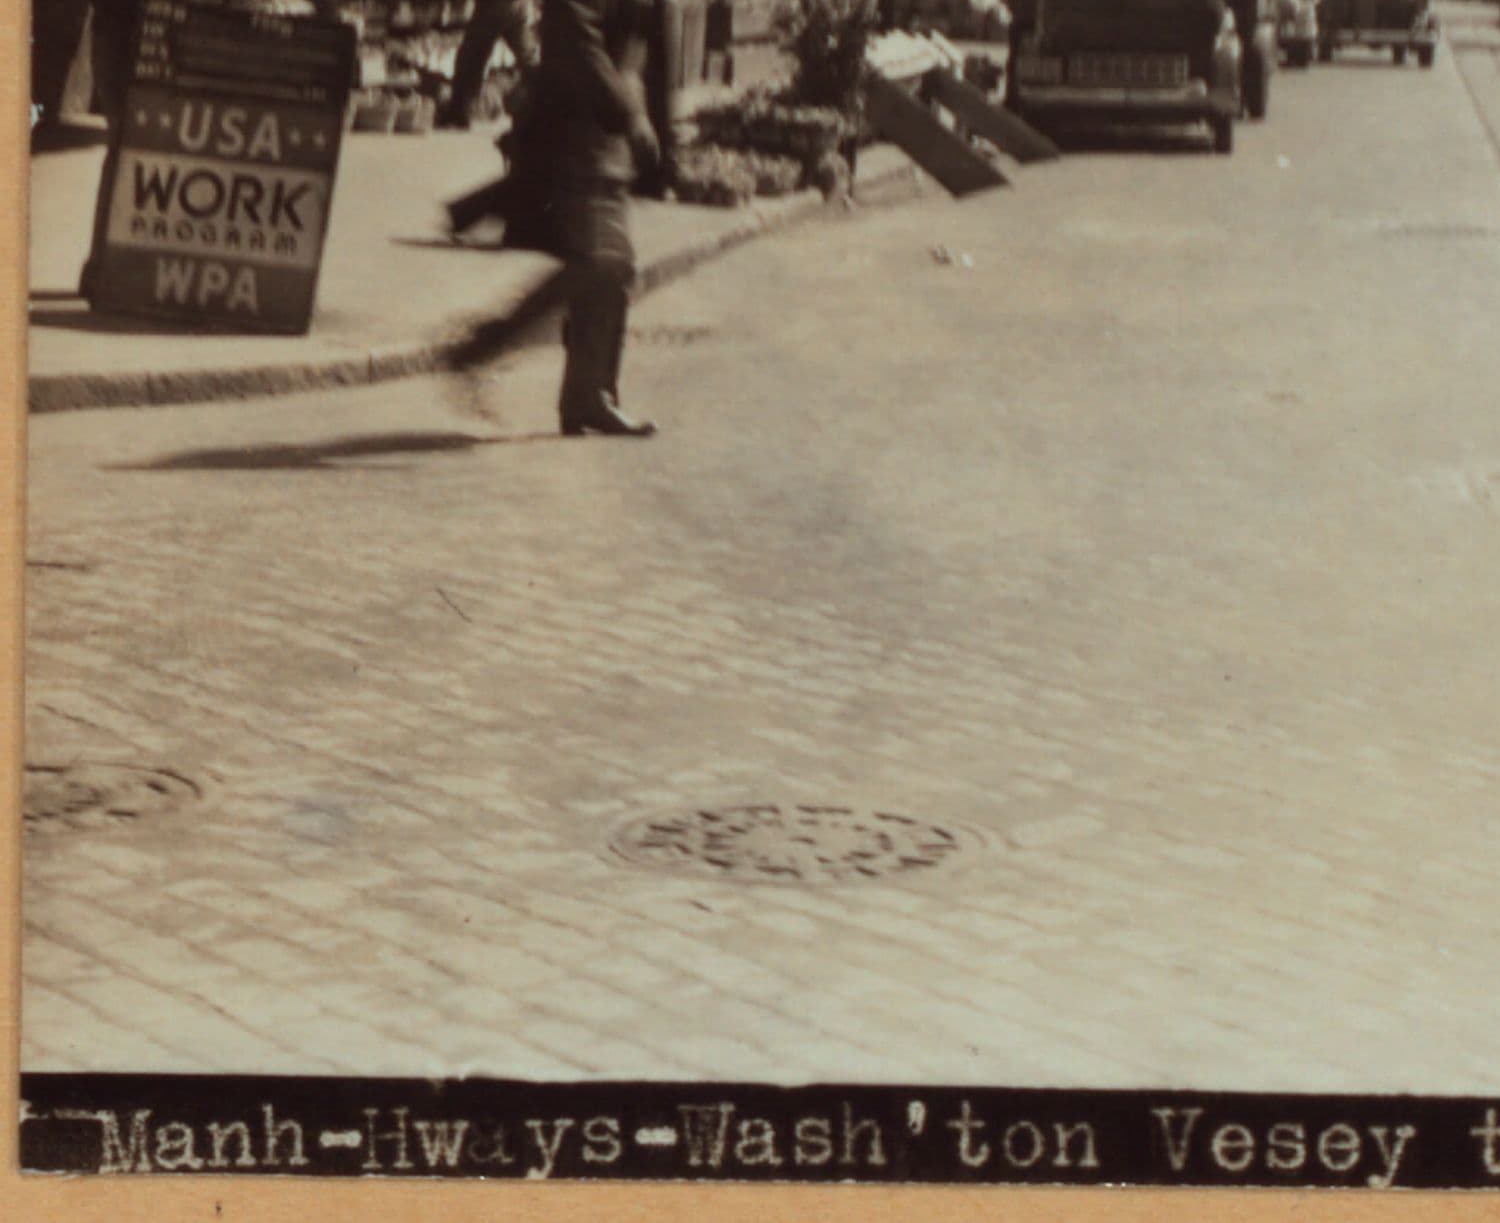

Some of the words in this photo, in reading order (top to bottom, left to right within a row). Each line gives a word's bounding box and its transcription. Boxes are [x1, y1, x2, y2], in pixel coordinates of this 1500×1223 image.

[180, 100, 282, 161] USA
[133, 159, 310, 231] WORK
[131, 215, 298, 255] PROGRAM
[154, 257, 259, 314] WPA
